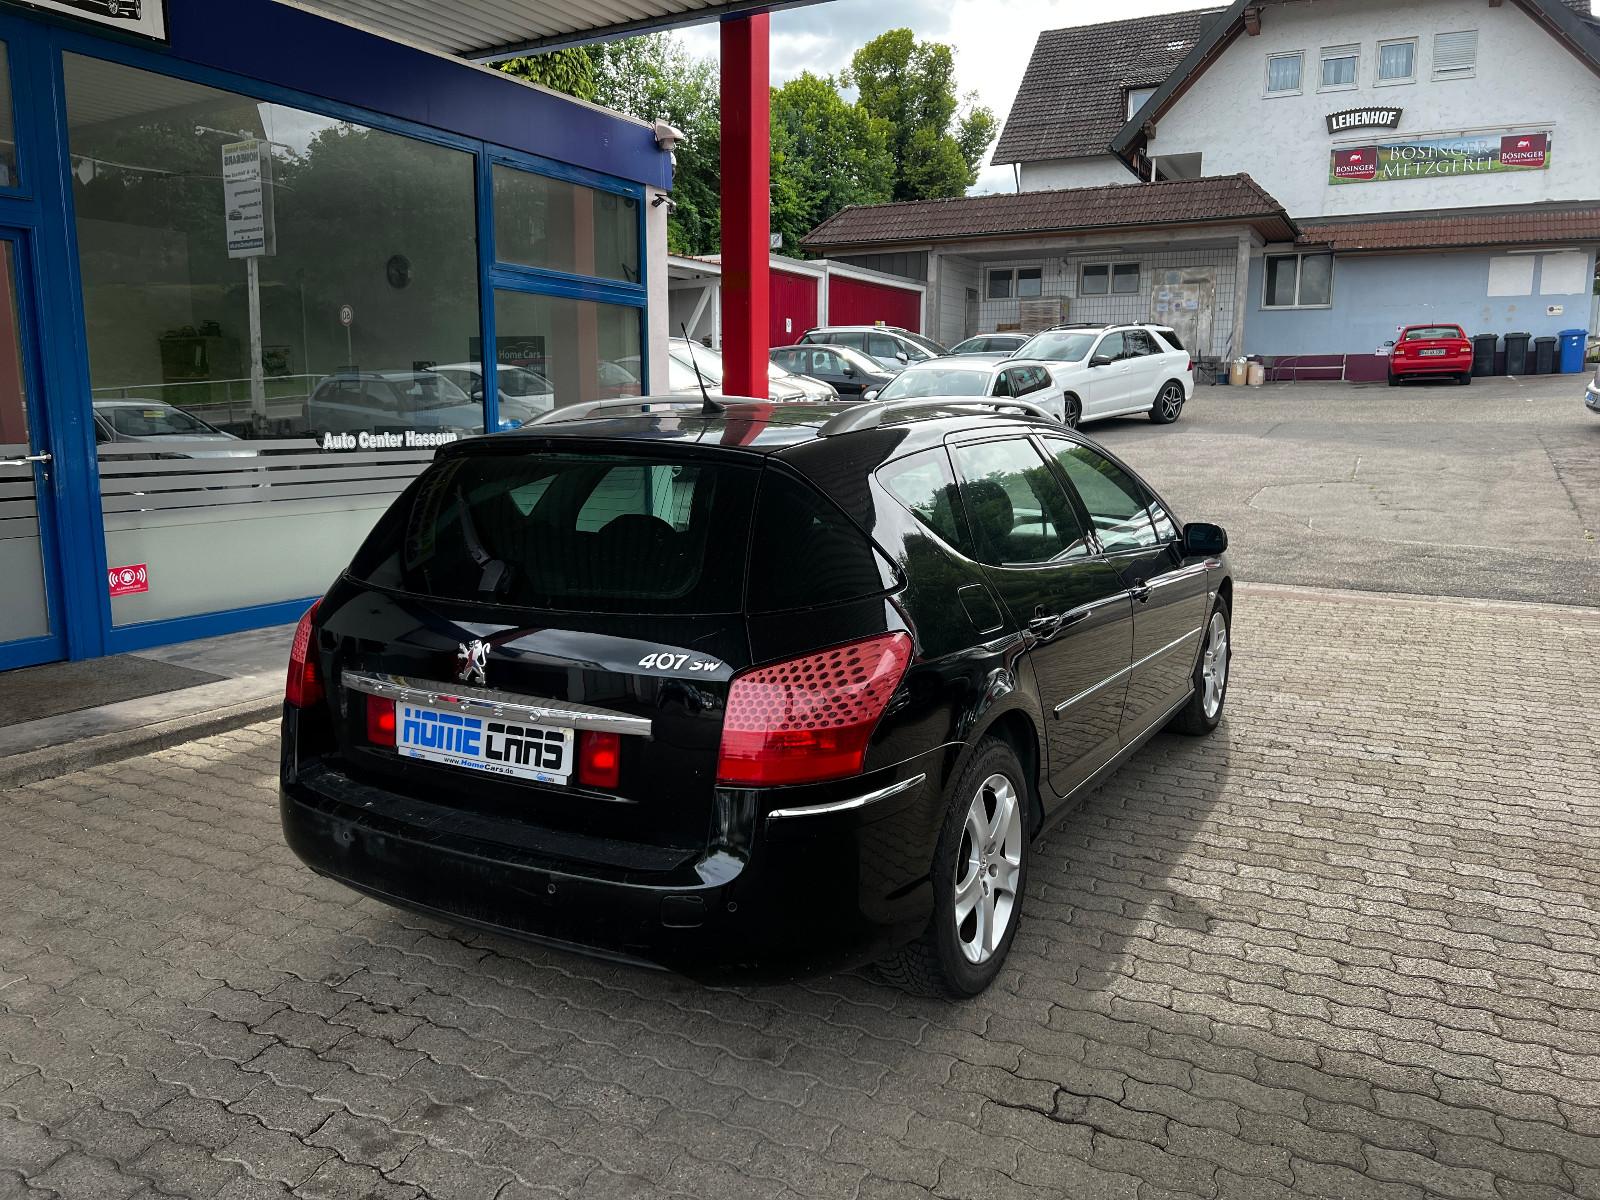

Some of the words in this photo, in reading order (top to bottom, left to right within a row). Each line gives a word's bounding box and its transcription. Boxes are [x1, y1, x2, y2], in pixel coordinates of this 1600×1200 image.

[1332, 110, 1397, 130] LEHENHOF
[1383, 156, 1492, 178] METZGEREI
[499, 350, 522, 359] Home
[523, 350, 541, 359] Cars
[322, 431, 357, 450] Auto
[358, 431, 404, 449] Center
[638, 652, 691, 670] 407
[443, 755, 514, 775] www.HomeCars.de
